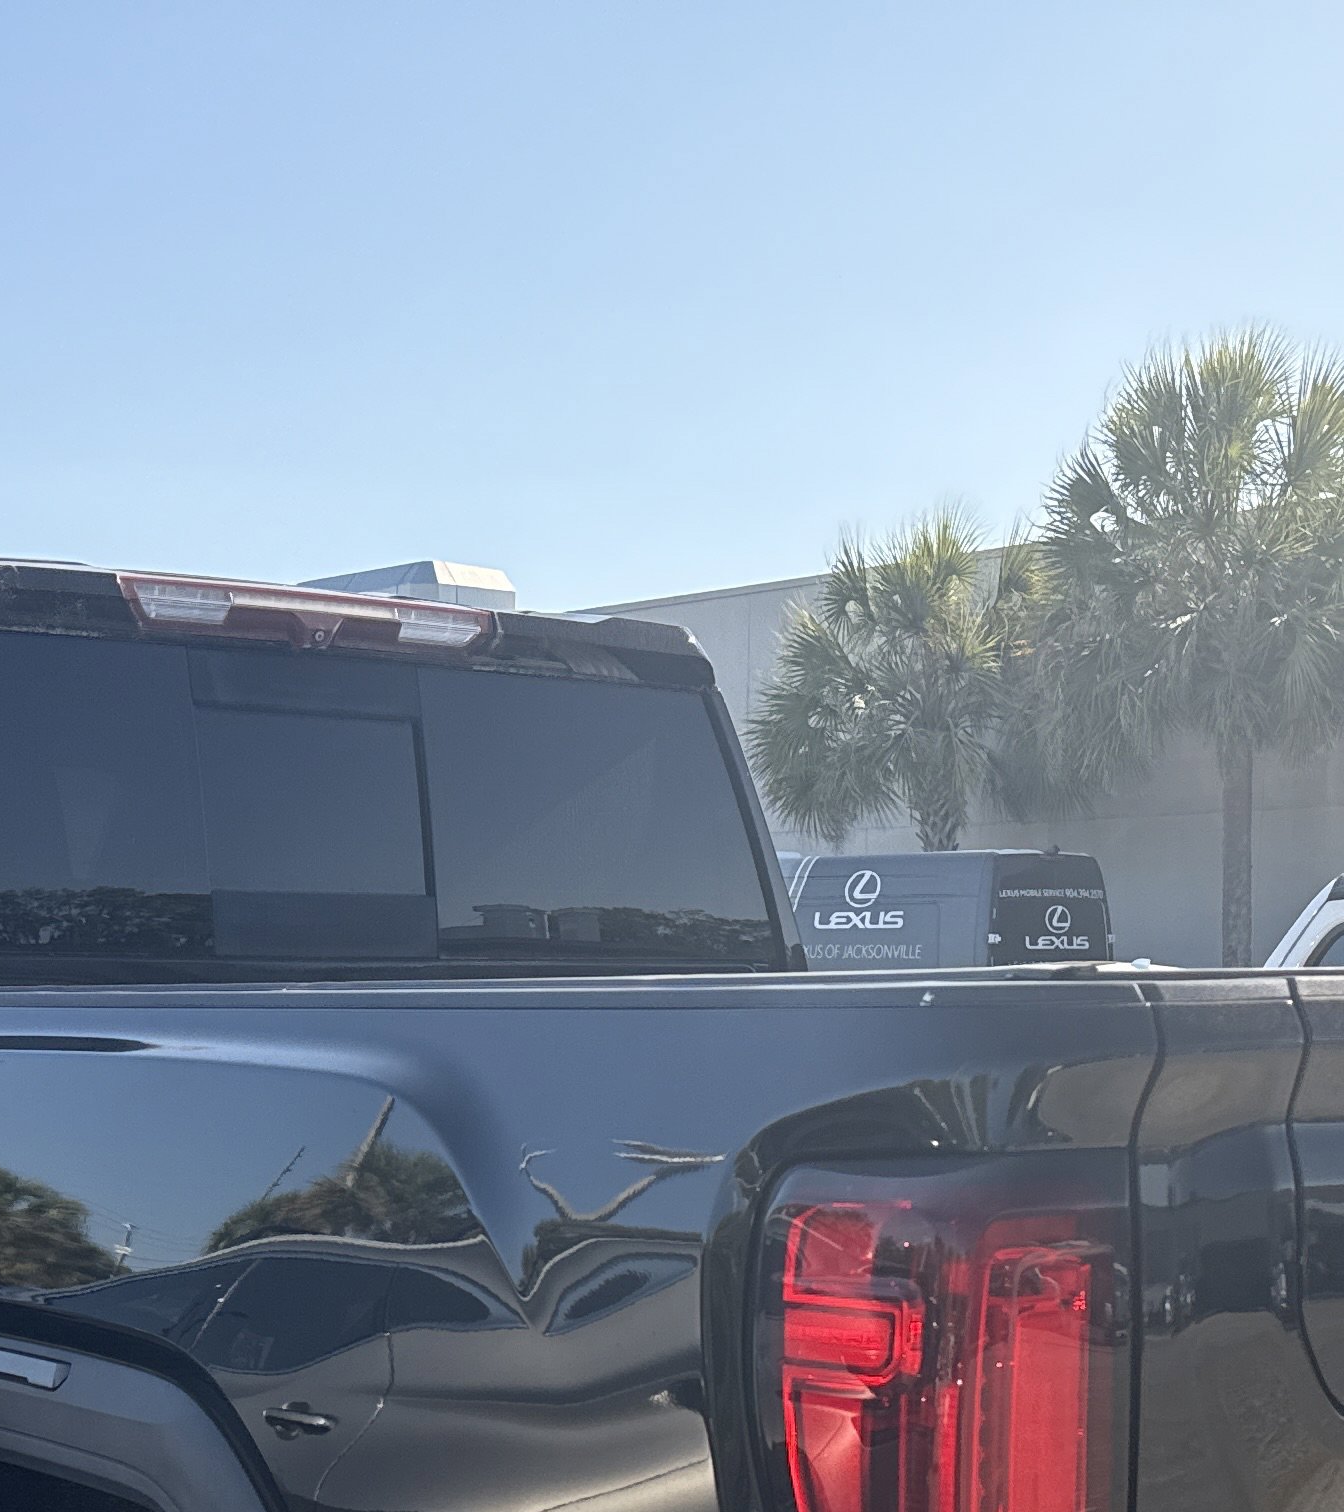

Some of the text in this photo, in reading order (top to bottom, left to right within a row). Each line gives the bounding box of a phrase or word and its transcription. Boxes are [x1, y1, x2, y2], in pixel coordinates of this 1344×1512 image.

[813, 910, 904, 929] LEXUS
[1025, 935, 1090, 949] LEXUS
[803, 944, 922, 959] XUS OF JACKSONVILLE
